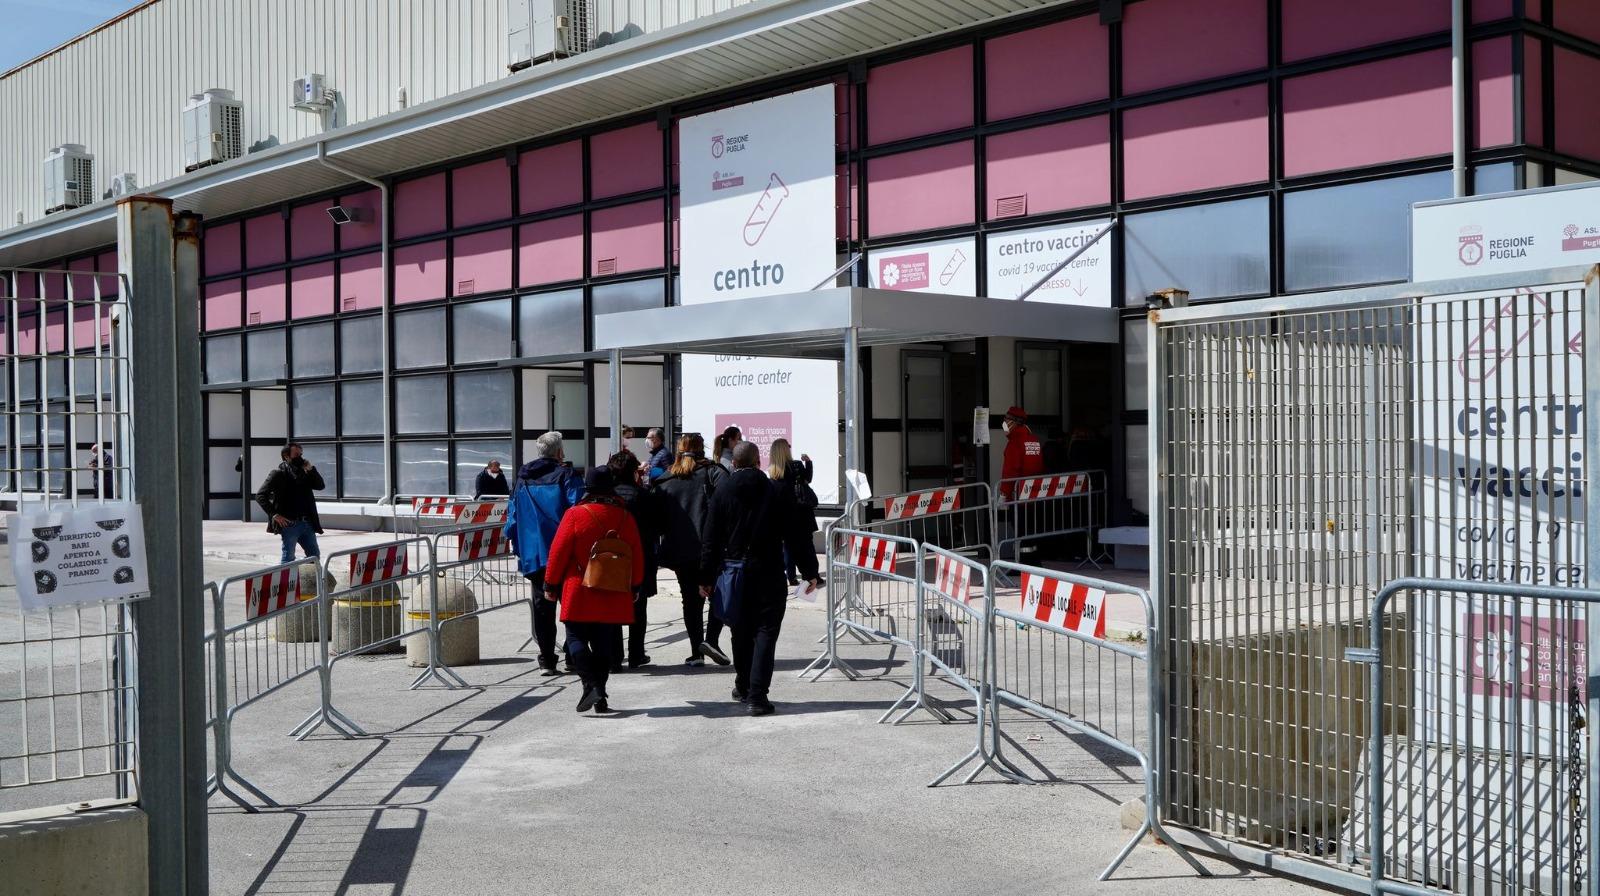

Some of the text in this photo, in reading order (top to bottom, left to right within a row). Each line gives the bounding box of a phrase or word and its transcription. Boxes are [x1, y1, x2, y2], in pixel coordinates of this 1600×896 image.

[726, 134, 749, 146] REGIONE
[726, 144, 746, 154] PUGLIA
[1584, 226, 1599, 234] ASL
[999, 238, 1044, 256] centro
[1489, 236, 1535, 250] REGIONE
[1489, 248, 1527, 260] PUGLIA
[998, 256, 1100, 277] covid 19 vaccie center
[713, 259, 784, 291] centro
[1032, 278, 1071, 291] GRESSO
[715, 369, 792, 387] vaccine center
[1457, 451, 1582, 498] vacci
[59, 531, 101, 542] BIRRIFICIO
[1458, 522, 1516, 544] covd
[71, 541, 90, 550] BARI
[63, 550, 95, 560] APERTO
[57, 559, 103, 570] COLAZIONE
[68, 568, 100, 578] PRANZO
[1458, 562, 1546, 583] vacine
[1035, 590, 1056, 609] POLIZIA
[1057, 596, 1077, 615] LOCALE
[1083, 602, 1097, 621] BARI
